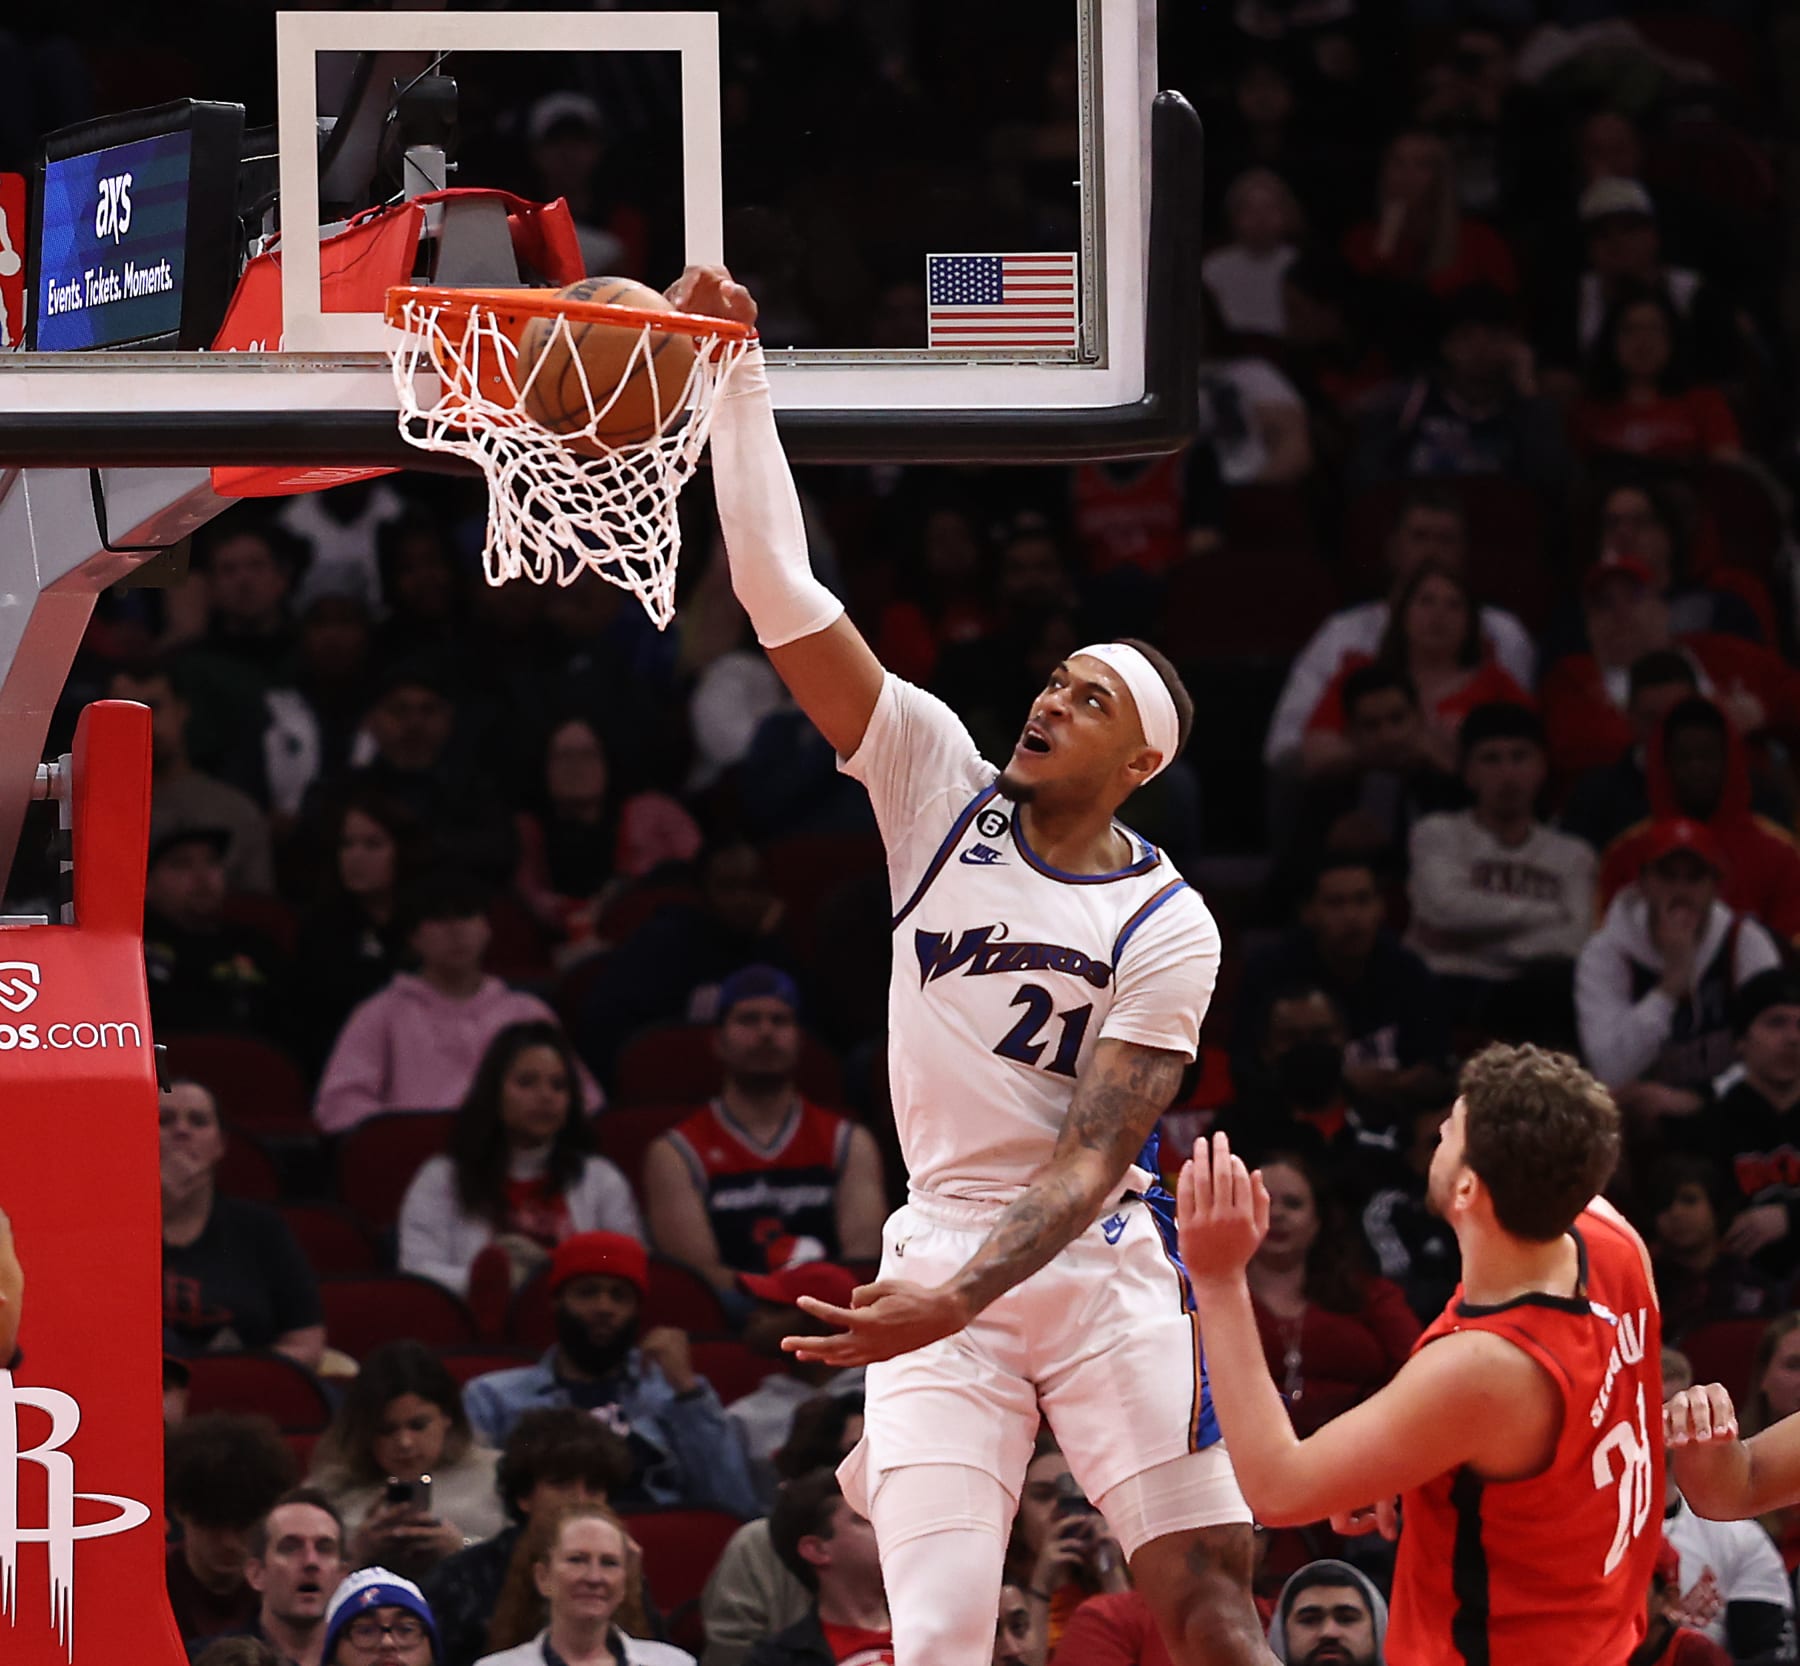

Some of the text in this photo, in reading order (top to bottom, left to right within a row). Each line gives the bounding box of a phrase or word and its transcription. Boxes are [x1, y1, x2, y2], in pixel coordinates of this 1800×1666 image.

[48, 257, 173, 316] Events. Tickets. Moments.
[992, 983, 1093, 1079] 21
